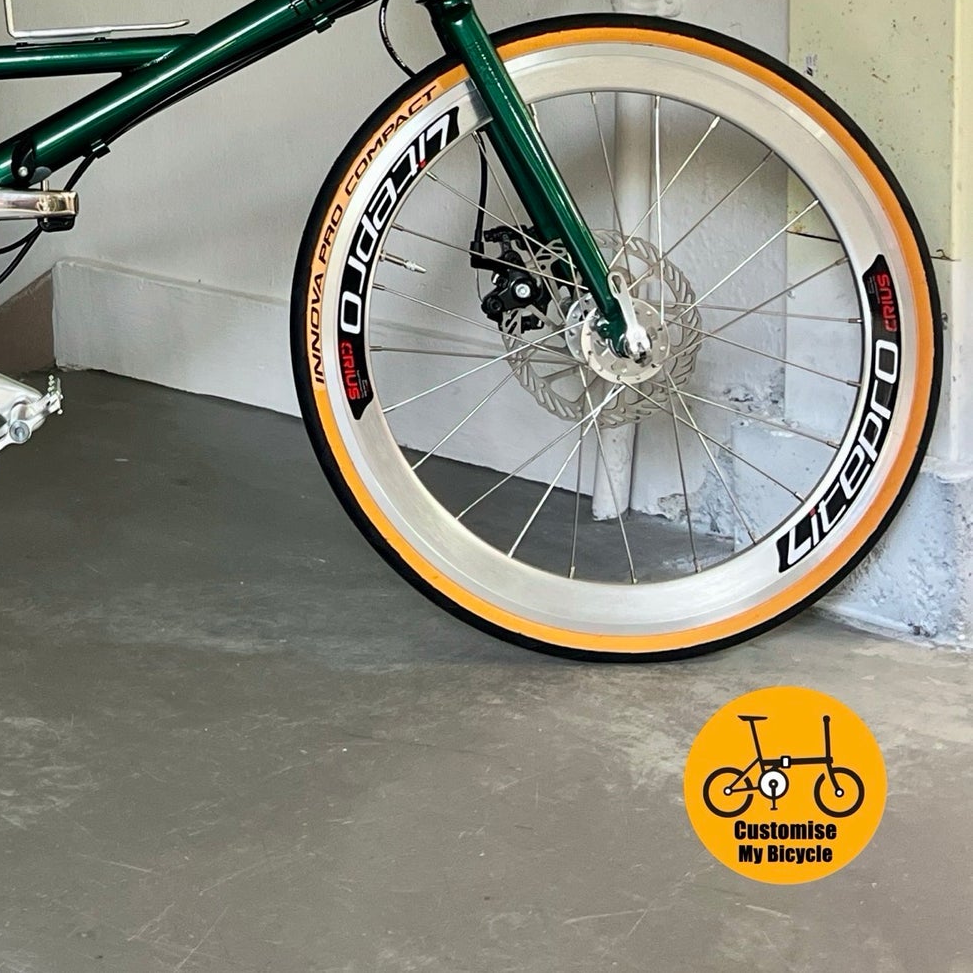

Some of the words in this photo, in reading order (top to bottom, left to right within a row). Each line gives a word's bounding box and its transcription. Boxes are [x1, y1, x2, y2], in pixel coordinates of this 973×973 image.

[310, 273, 325, 384] INNOVA
[318, 203, 343, 265] PRO
[345, 85, 437, 197] COMPACT
[878, 273, 898, 332] CRIUS
[341, 342, 361, 401] CRIUS
